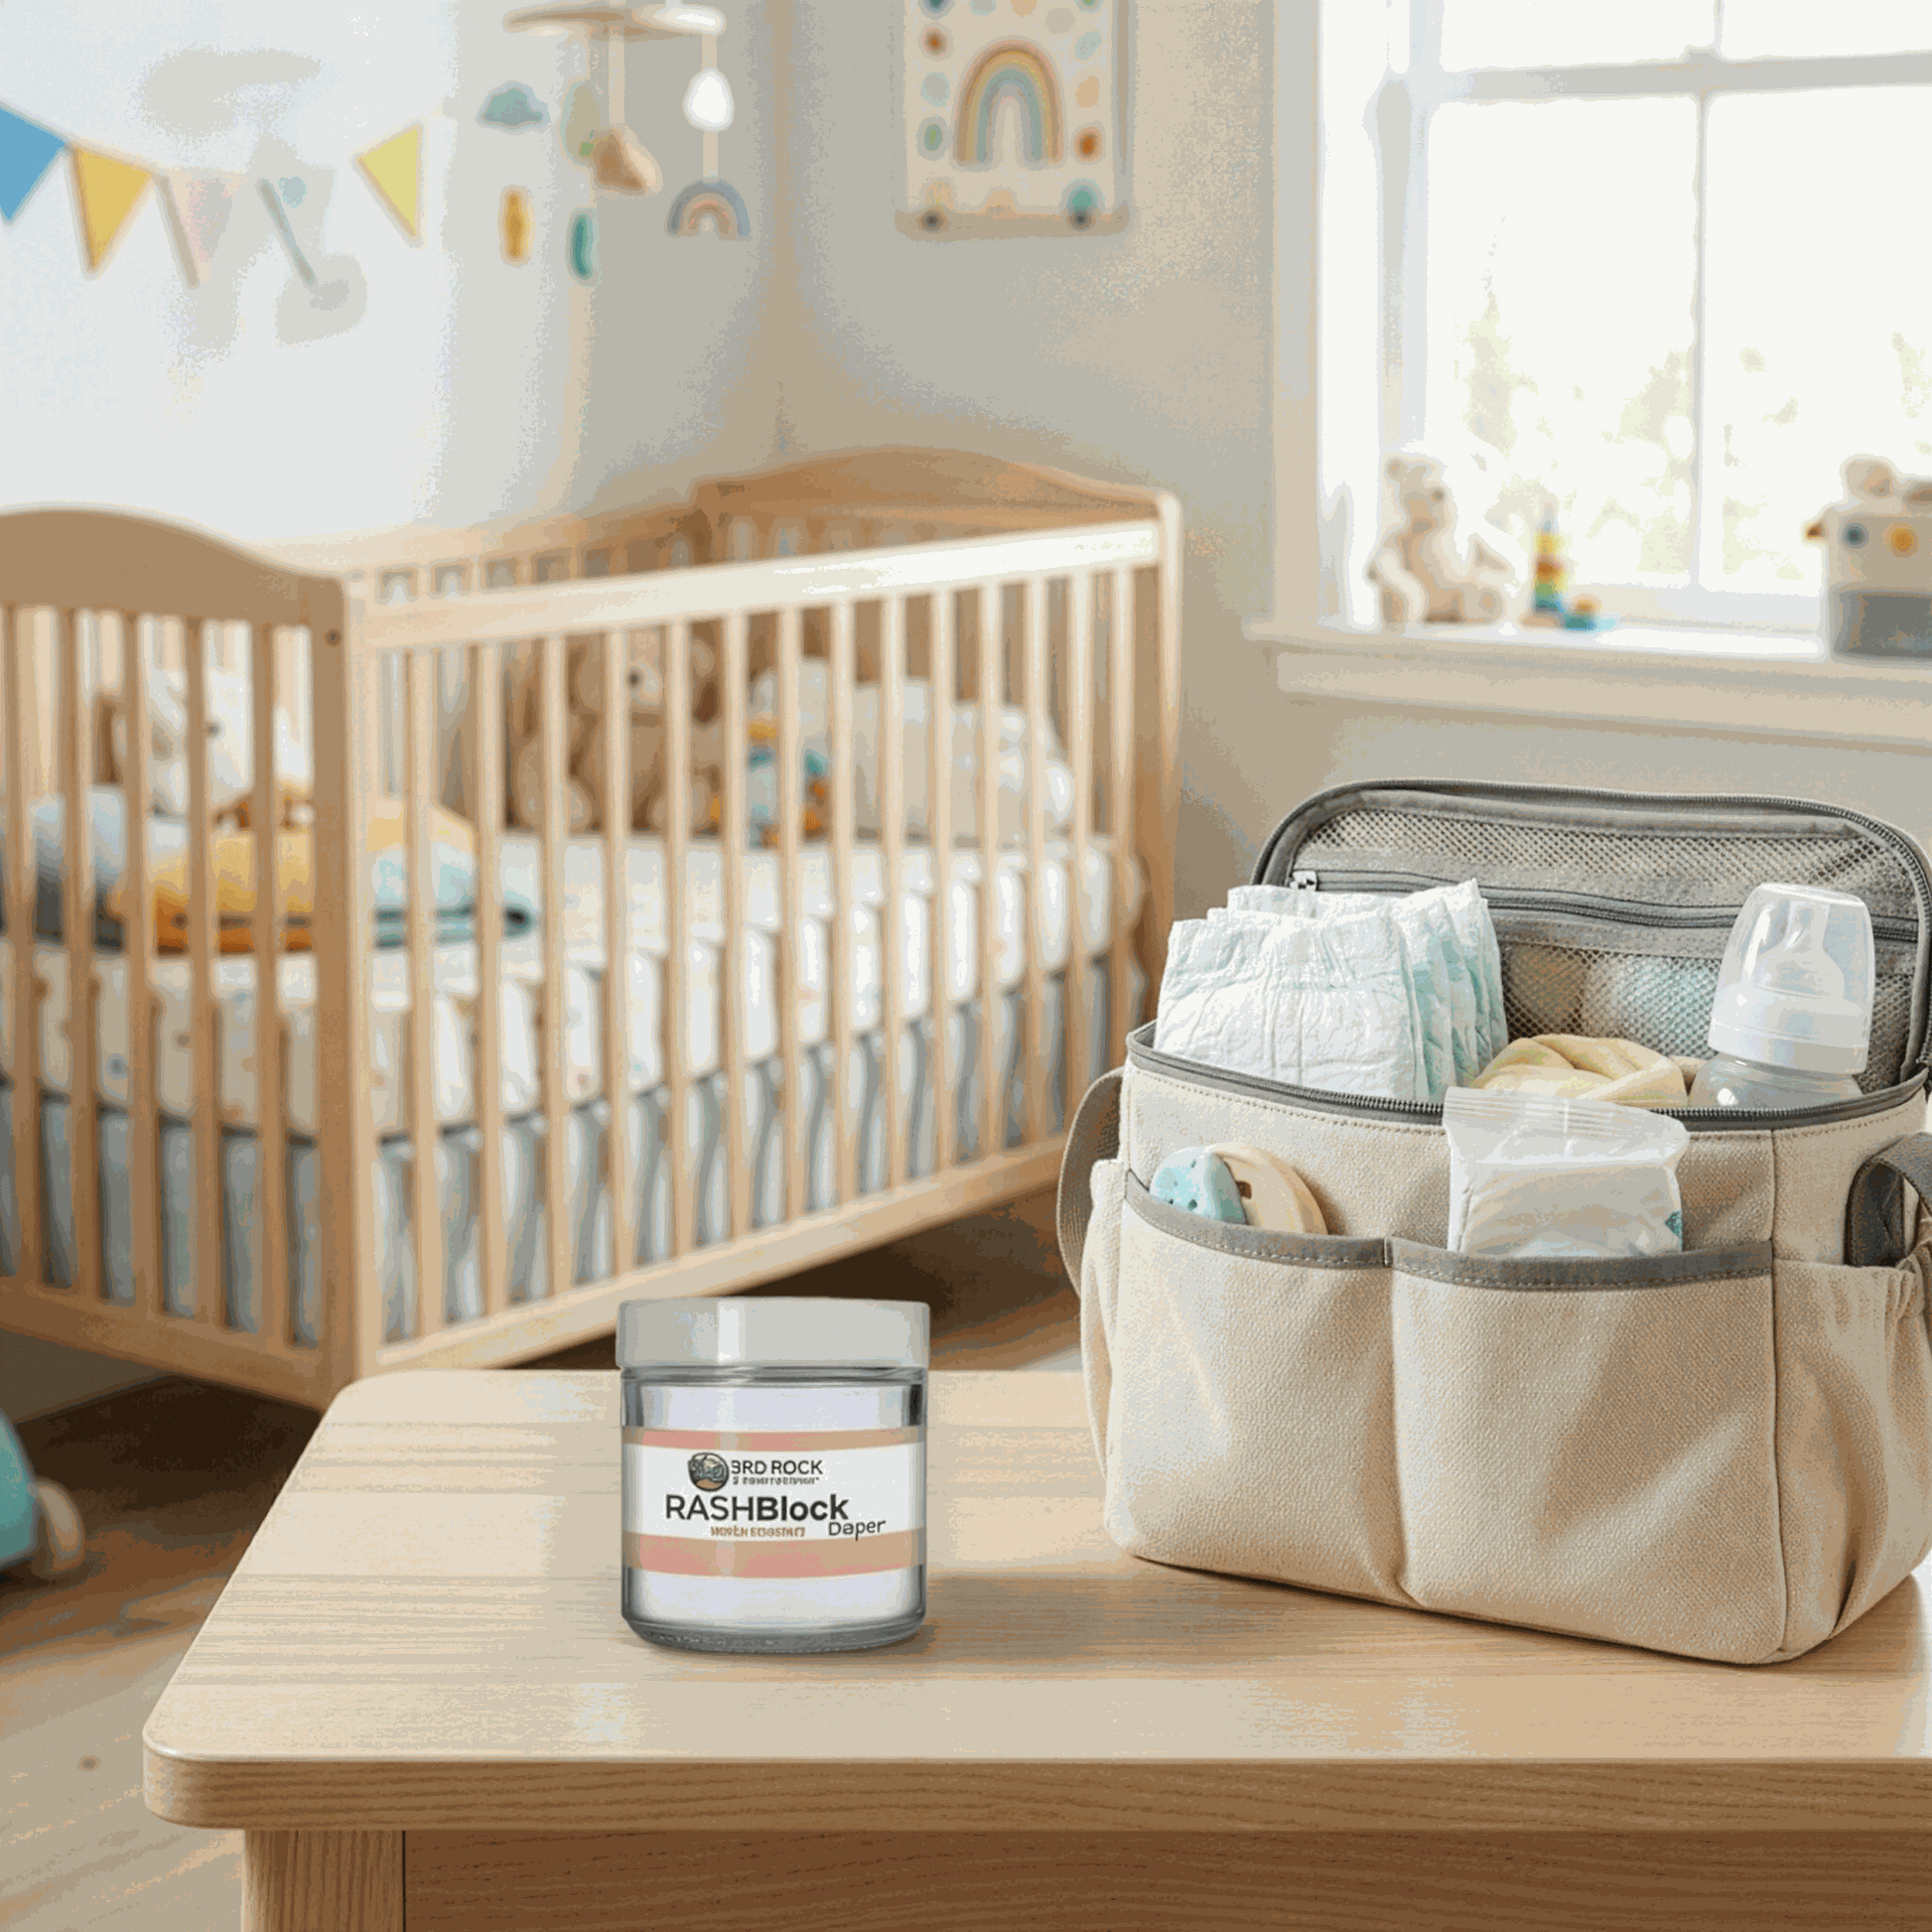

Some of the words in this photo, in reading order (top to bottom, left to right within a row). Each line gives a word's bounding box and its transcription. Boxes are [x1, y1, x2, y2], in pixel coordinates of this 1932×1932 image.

[731, 1459, 767, 1475] 3RD
[770, 1459, 823, 1475] ROCK
[665, 1493, 849, 1521] RASHBlock
[828, 1520, 887, 1542] Daper
